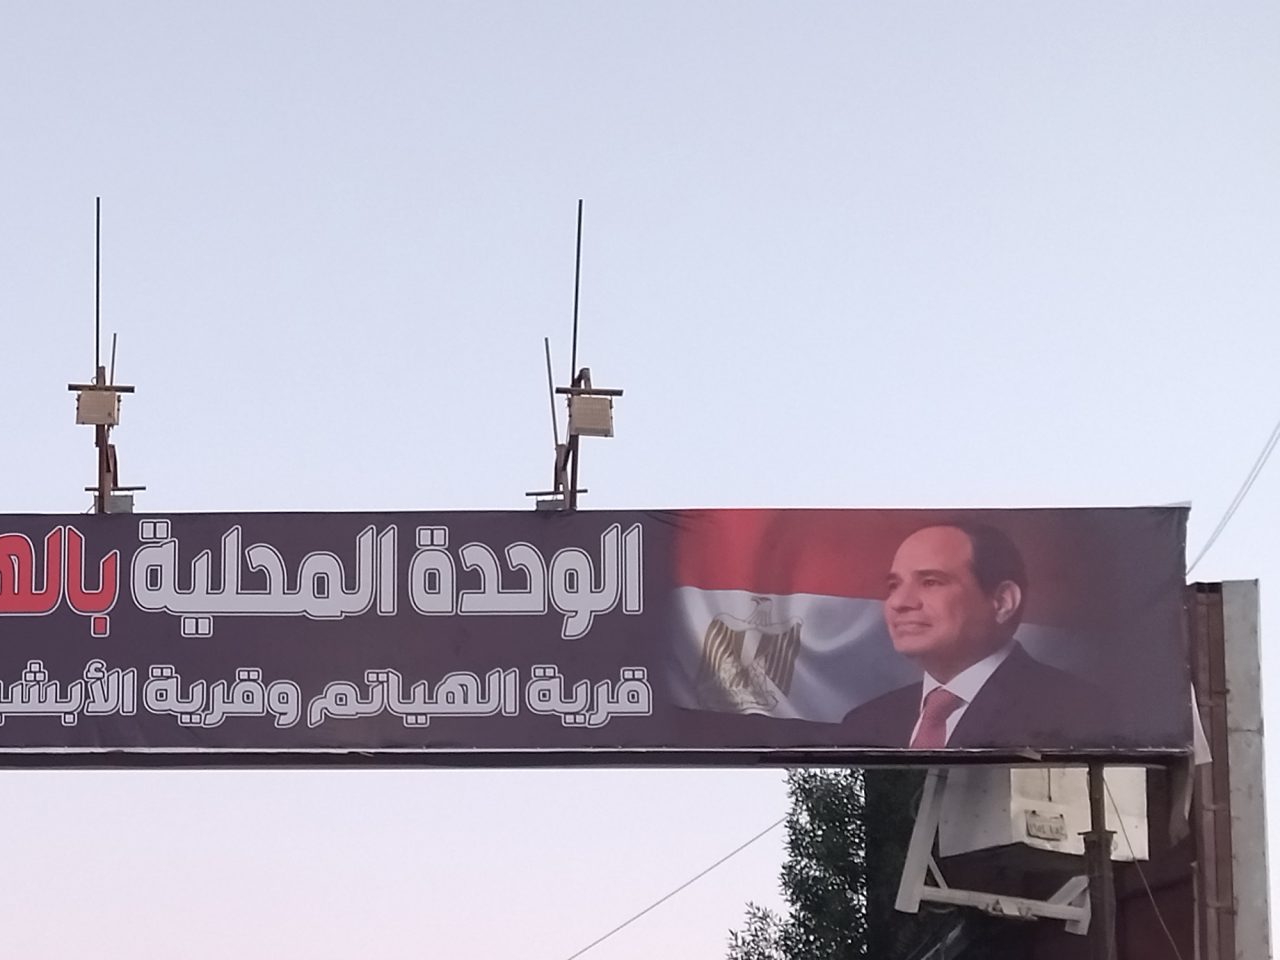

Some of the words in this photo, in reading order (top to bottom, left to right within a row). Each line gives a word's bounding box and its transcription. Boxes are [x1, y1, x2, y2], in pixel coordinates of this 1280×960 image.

[130, 519, 398, 637] المحلية
[408, 523, 643, 638] الوحدة
[144, 664, 300, 728] وقرية
[308, 668, 519, 728] الهياتم
[526, 665, 652, 728] قرية
